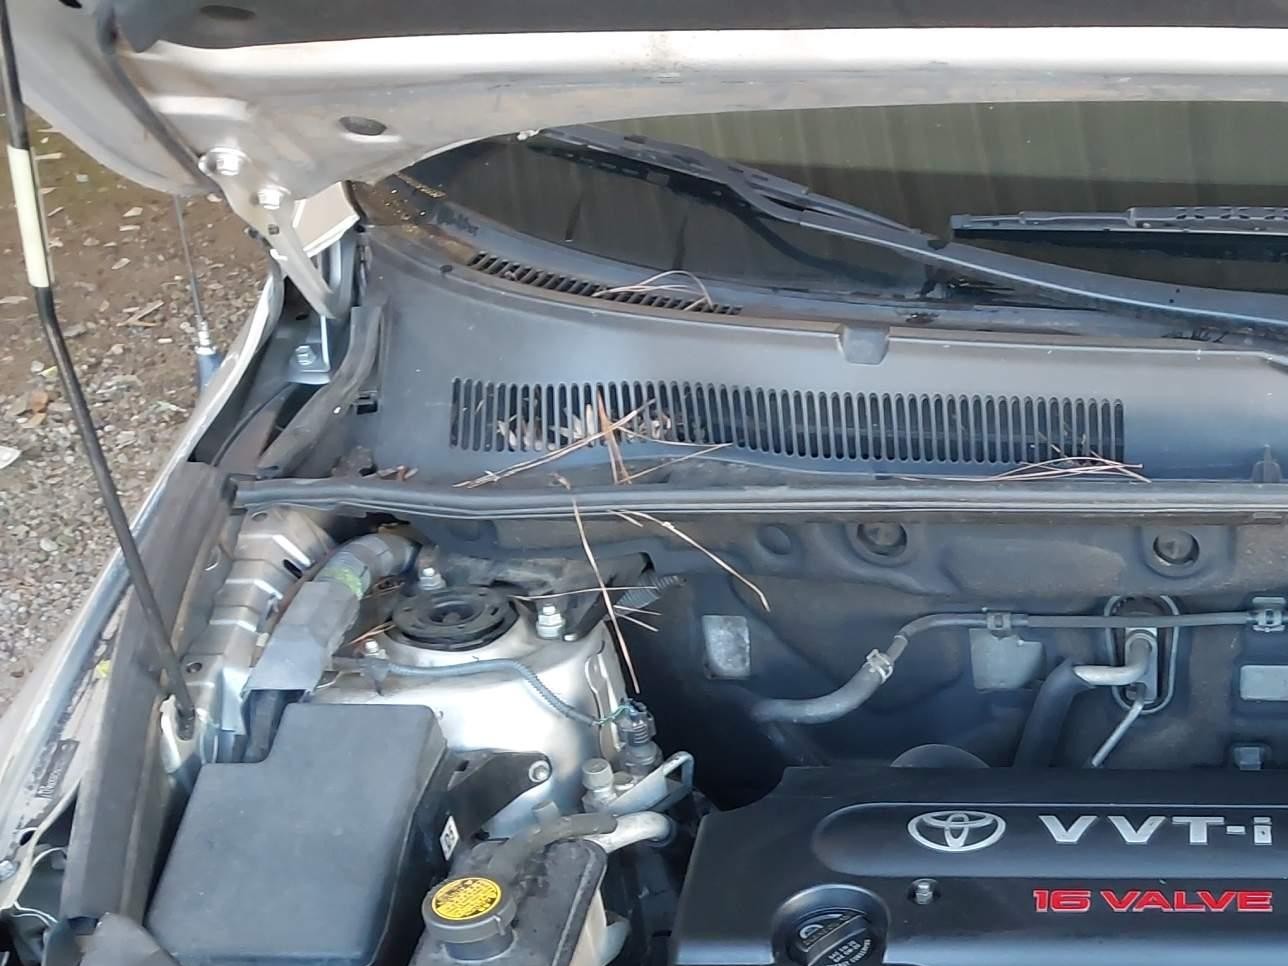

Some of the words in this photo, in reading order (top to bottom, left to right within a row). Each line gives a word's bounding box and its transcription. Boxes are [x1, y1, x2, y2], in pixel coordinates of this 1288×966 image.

[1038, 815, 1272, 845] VVT-i
[1033, 890, 1091, 912] 16
[1100, 890, 1273, 912] VALVE
